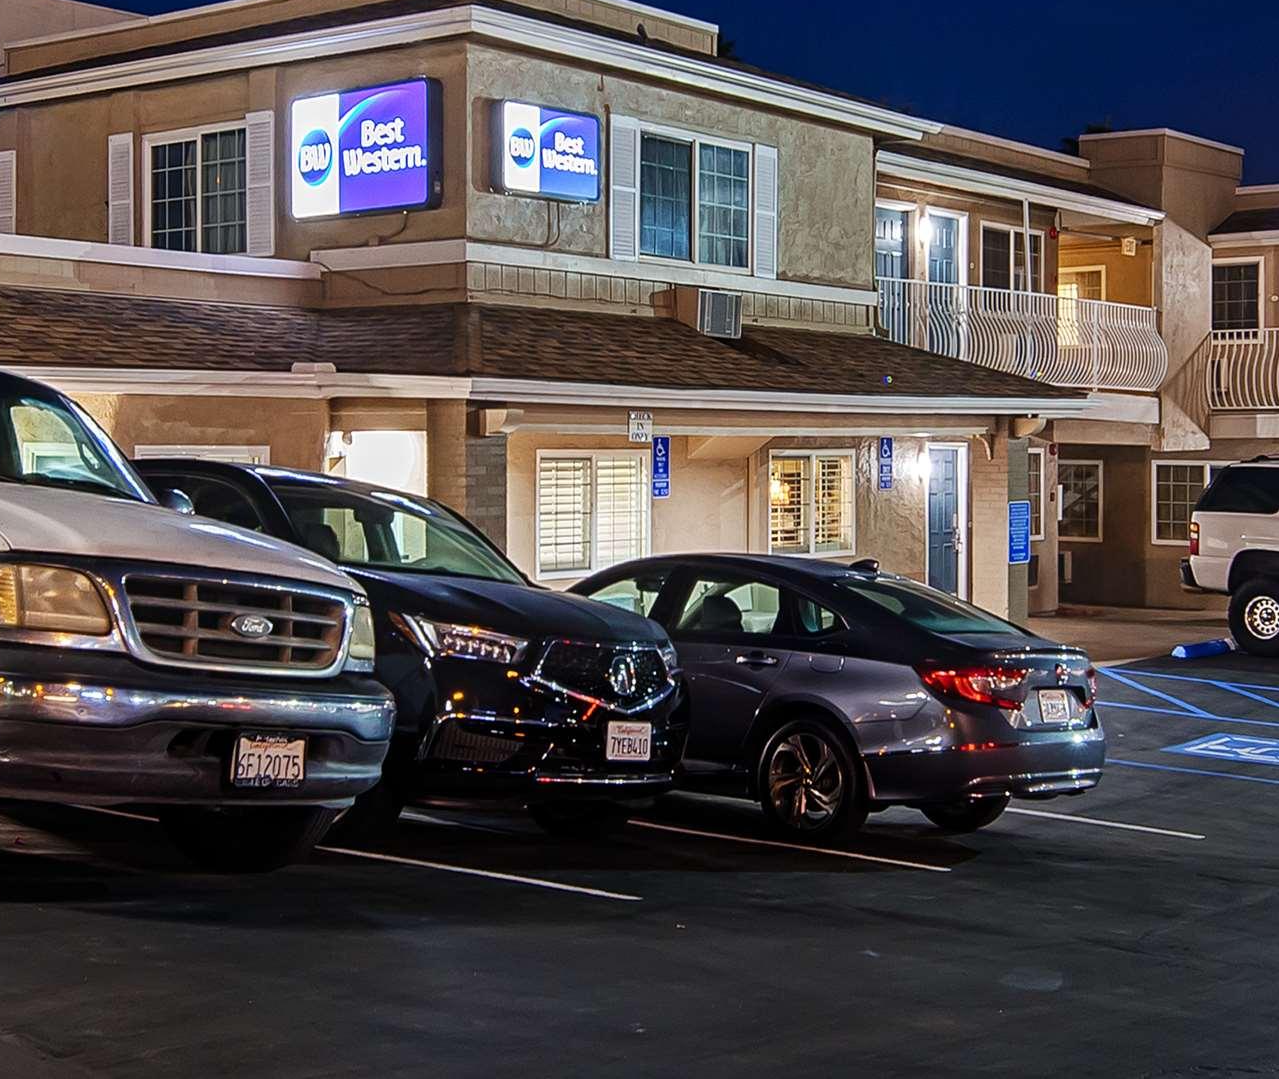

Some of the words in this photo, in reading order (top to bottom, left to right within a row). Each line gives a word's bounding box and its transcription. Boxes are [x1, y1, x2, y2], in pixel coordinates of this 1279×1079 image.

[360, 118, 406, 146] Best
[554, 131, 585, 154] Best
[300, 142, 331, 174] BW
[509, 136, 534, 160] BW
[241, 617, 265, 633] Ford
